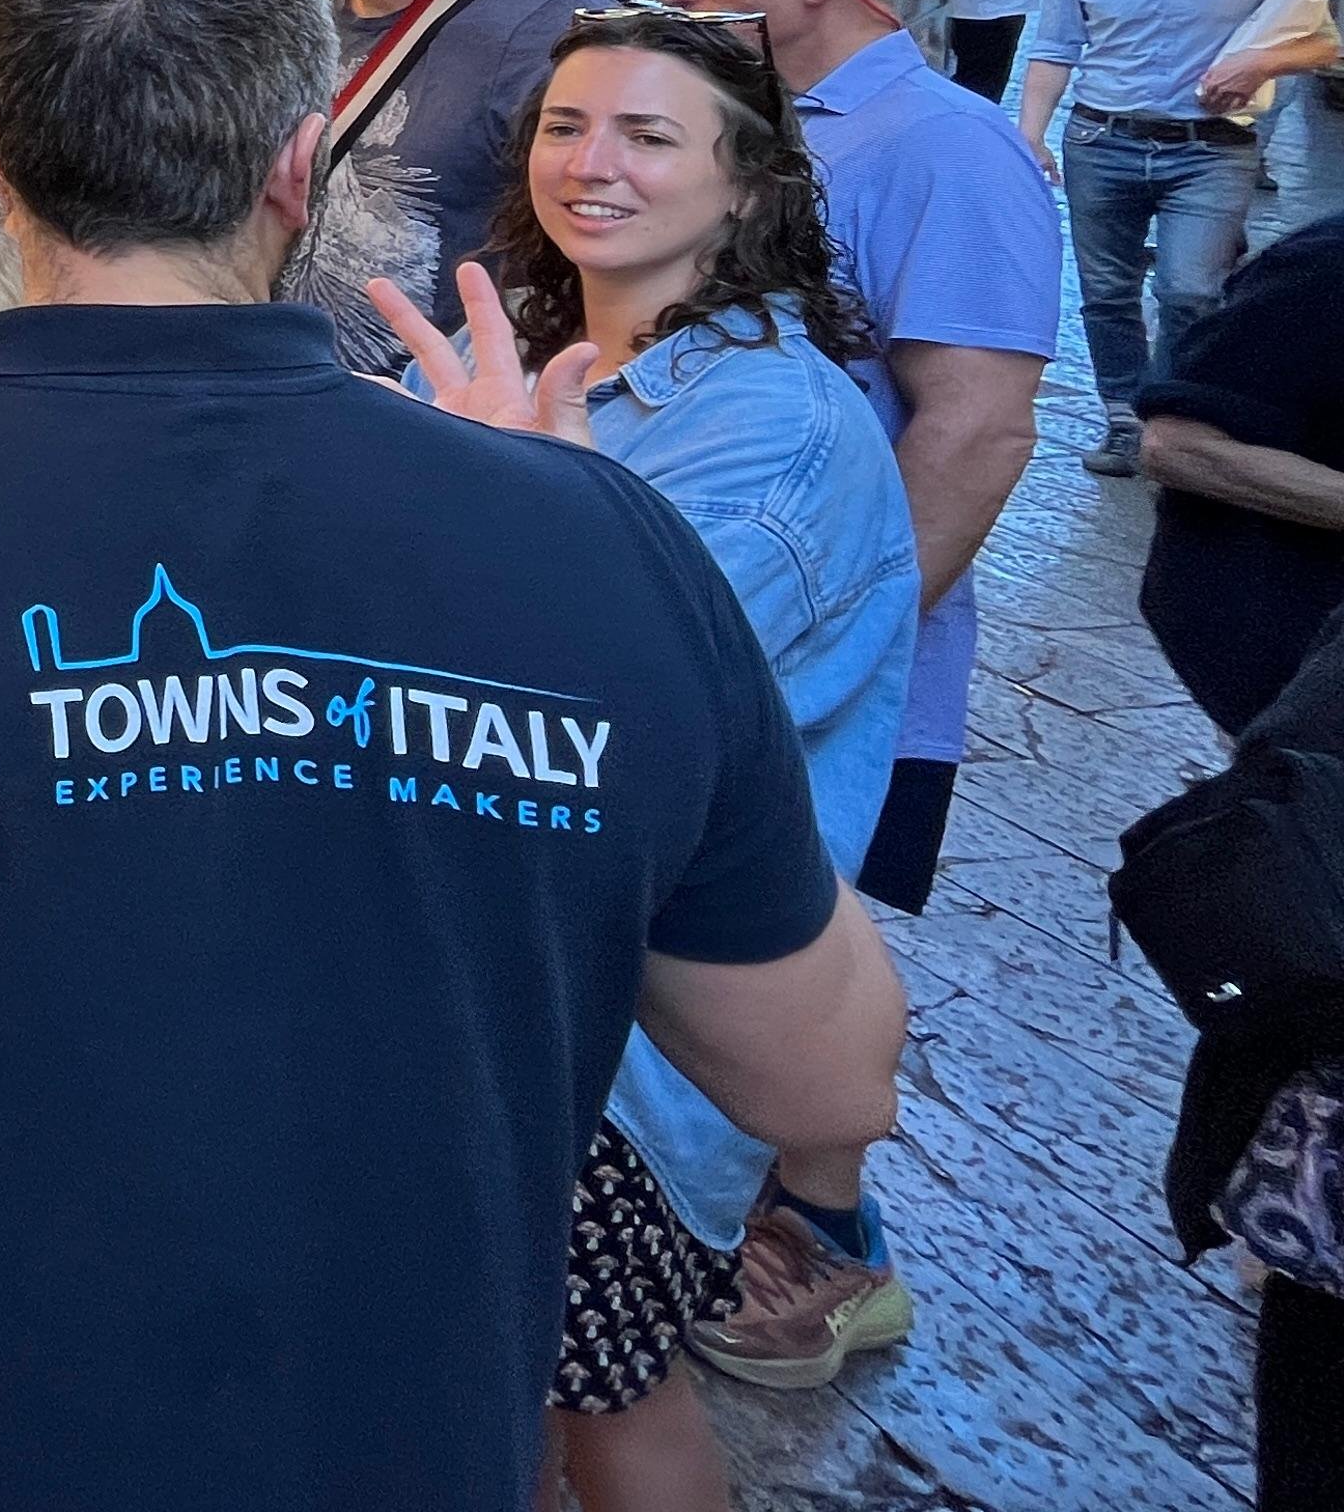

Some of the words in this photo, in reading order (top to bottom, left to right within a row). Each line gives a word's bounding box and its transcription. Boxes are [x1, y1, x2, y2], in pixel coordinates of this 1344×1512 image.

[30, 668, 314, 759] TOWNS
[325, 677, 376, 749] of
[389, 686, 611, 788] ITALY
[55, 756, 354, 806] EXPERIENCE
[389, 776, 603, 834] MAKERS
